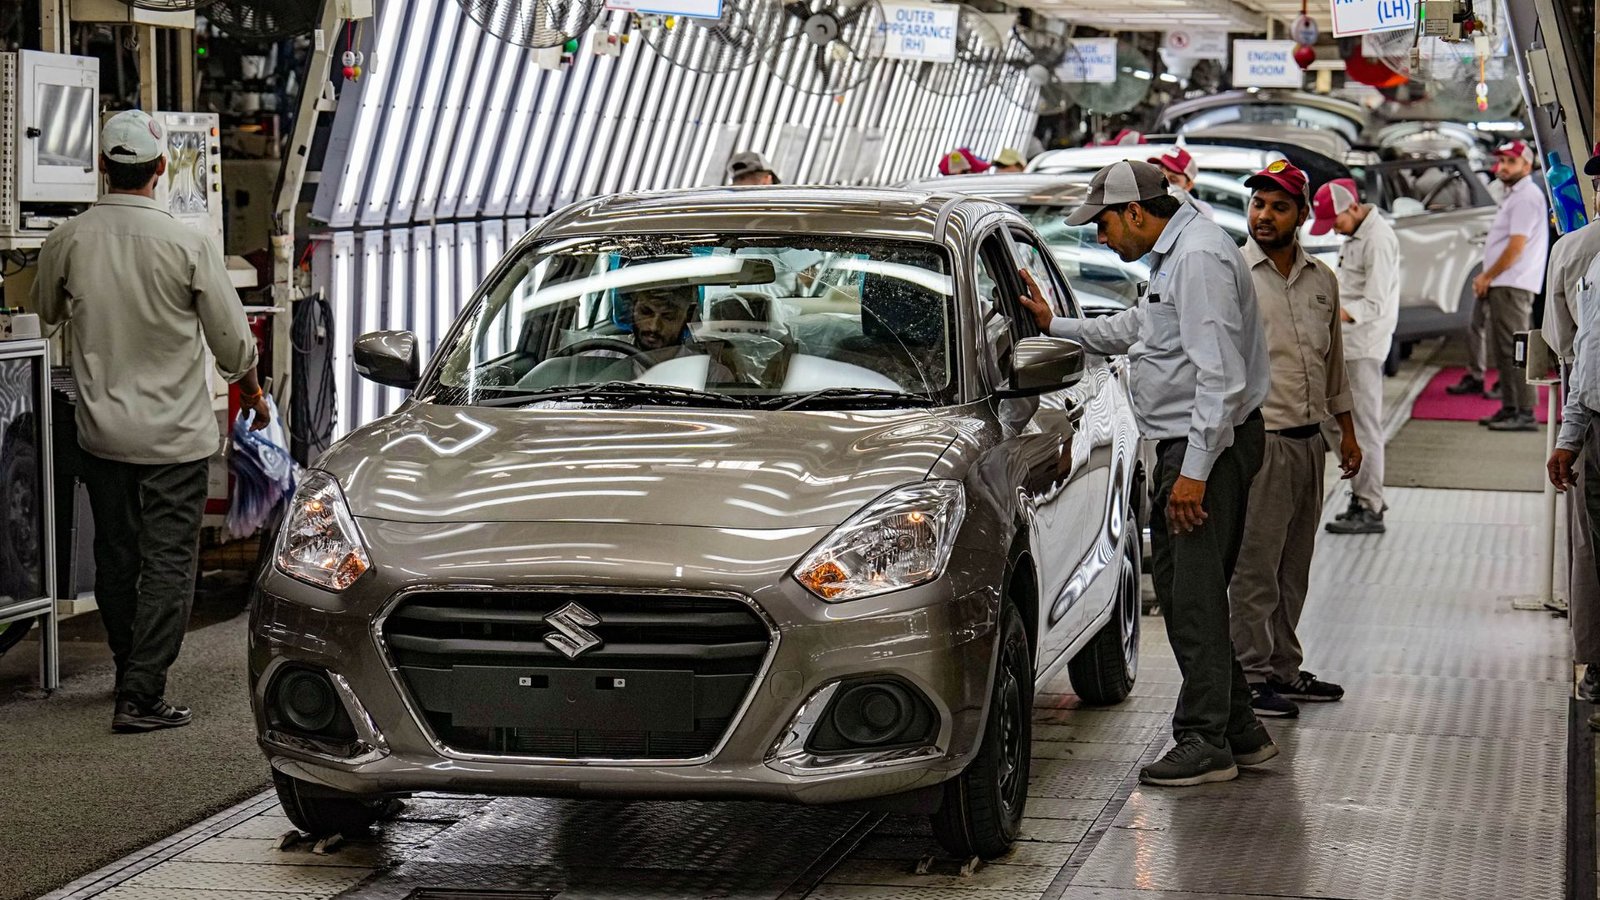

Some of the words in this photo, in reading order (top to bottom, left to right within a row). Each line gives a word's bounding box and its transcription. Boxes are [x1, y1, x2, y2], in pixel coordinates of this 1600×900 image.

[896, 9, 935, 24] OUTER
[1377, 0, 1411, 24] (LH)
[876, 22, 952, 39] APPEARANCE
[901, 37, 925, 53] (RH)
[1247, 51, 1288, 62] ENGINE
[1249, 64, 1286, 75] ROOM
